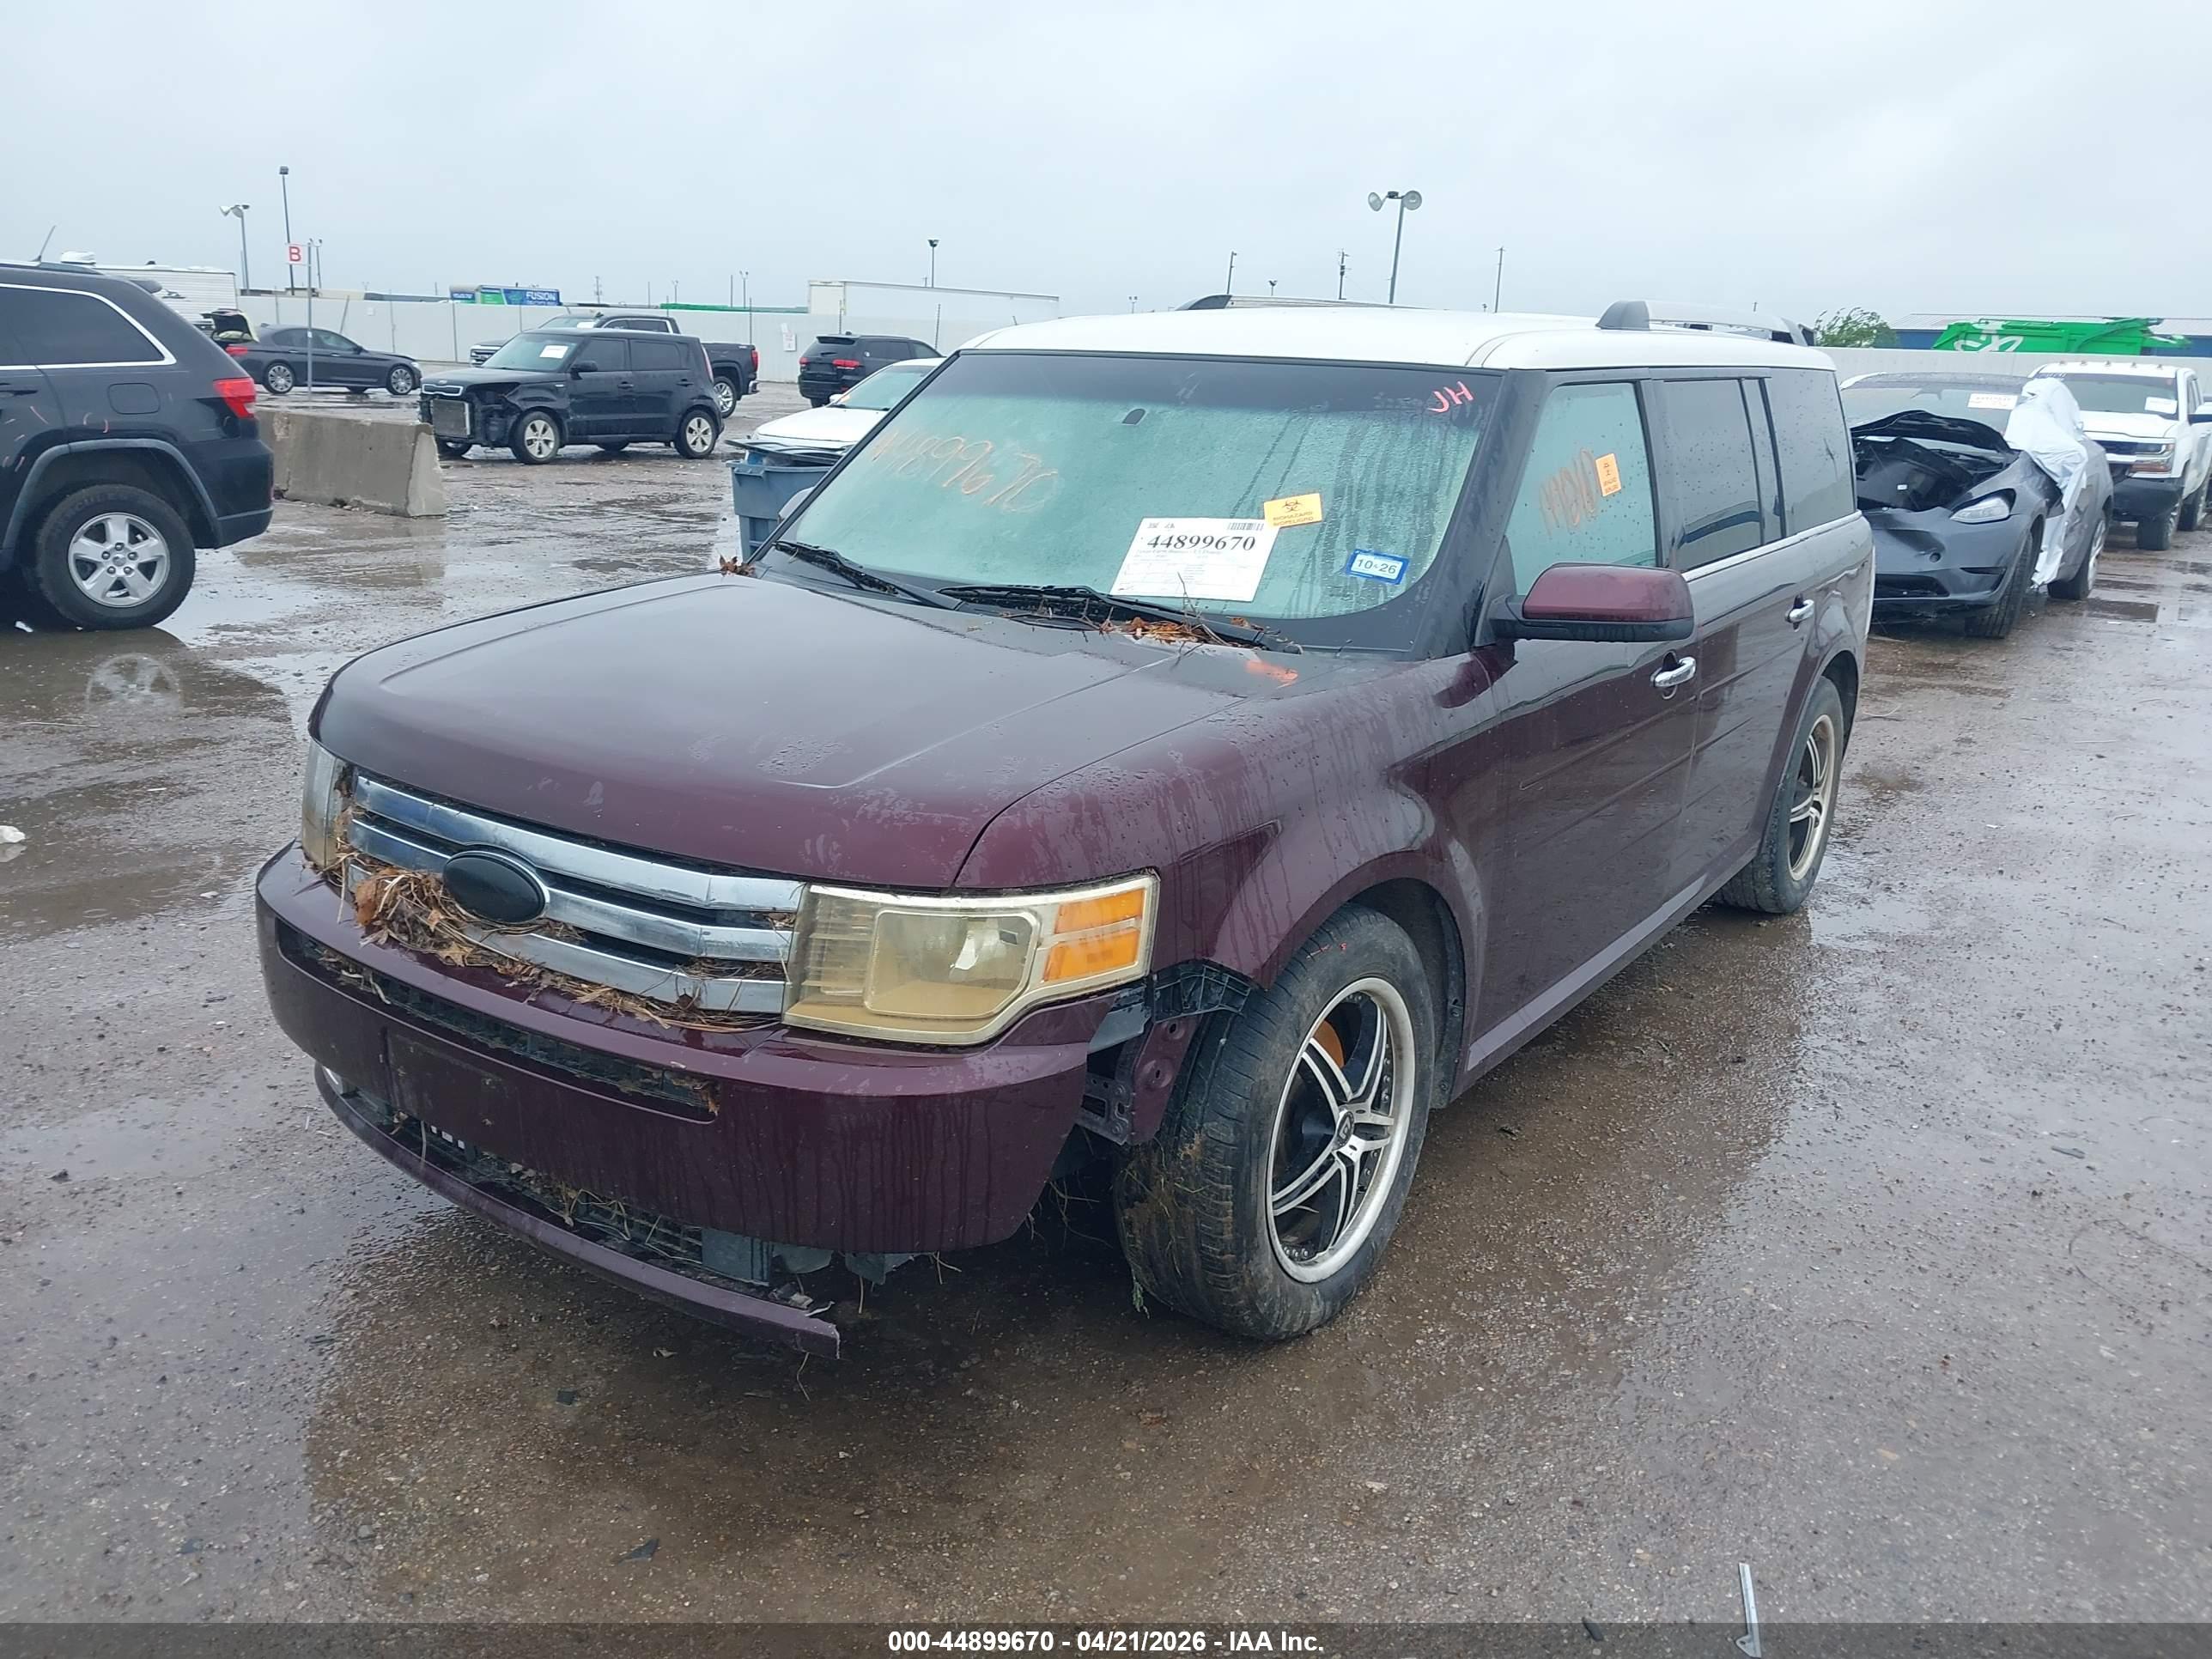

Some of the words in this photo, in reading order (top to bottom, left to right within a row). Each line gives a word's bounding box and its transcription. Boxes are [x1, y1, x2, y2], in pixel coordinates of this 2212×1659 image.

[289, 246, 301, 262] B
[526, 291, 557, 301] FUSION
[1147, 534, 1256, 550] 44899670
